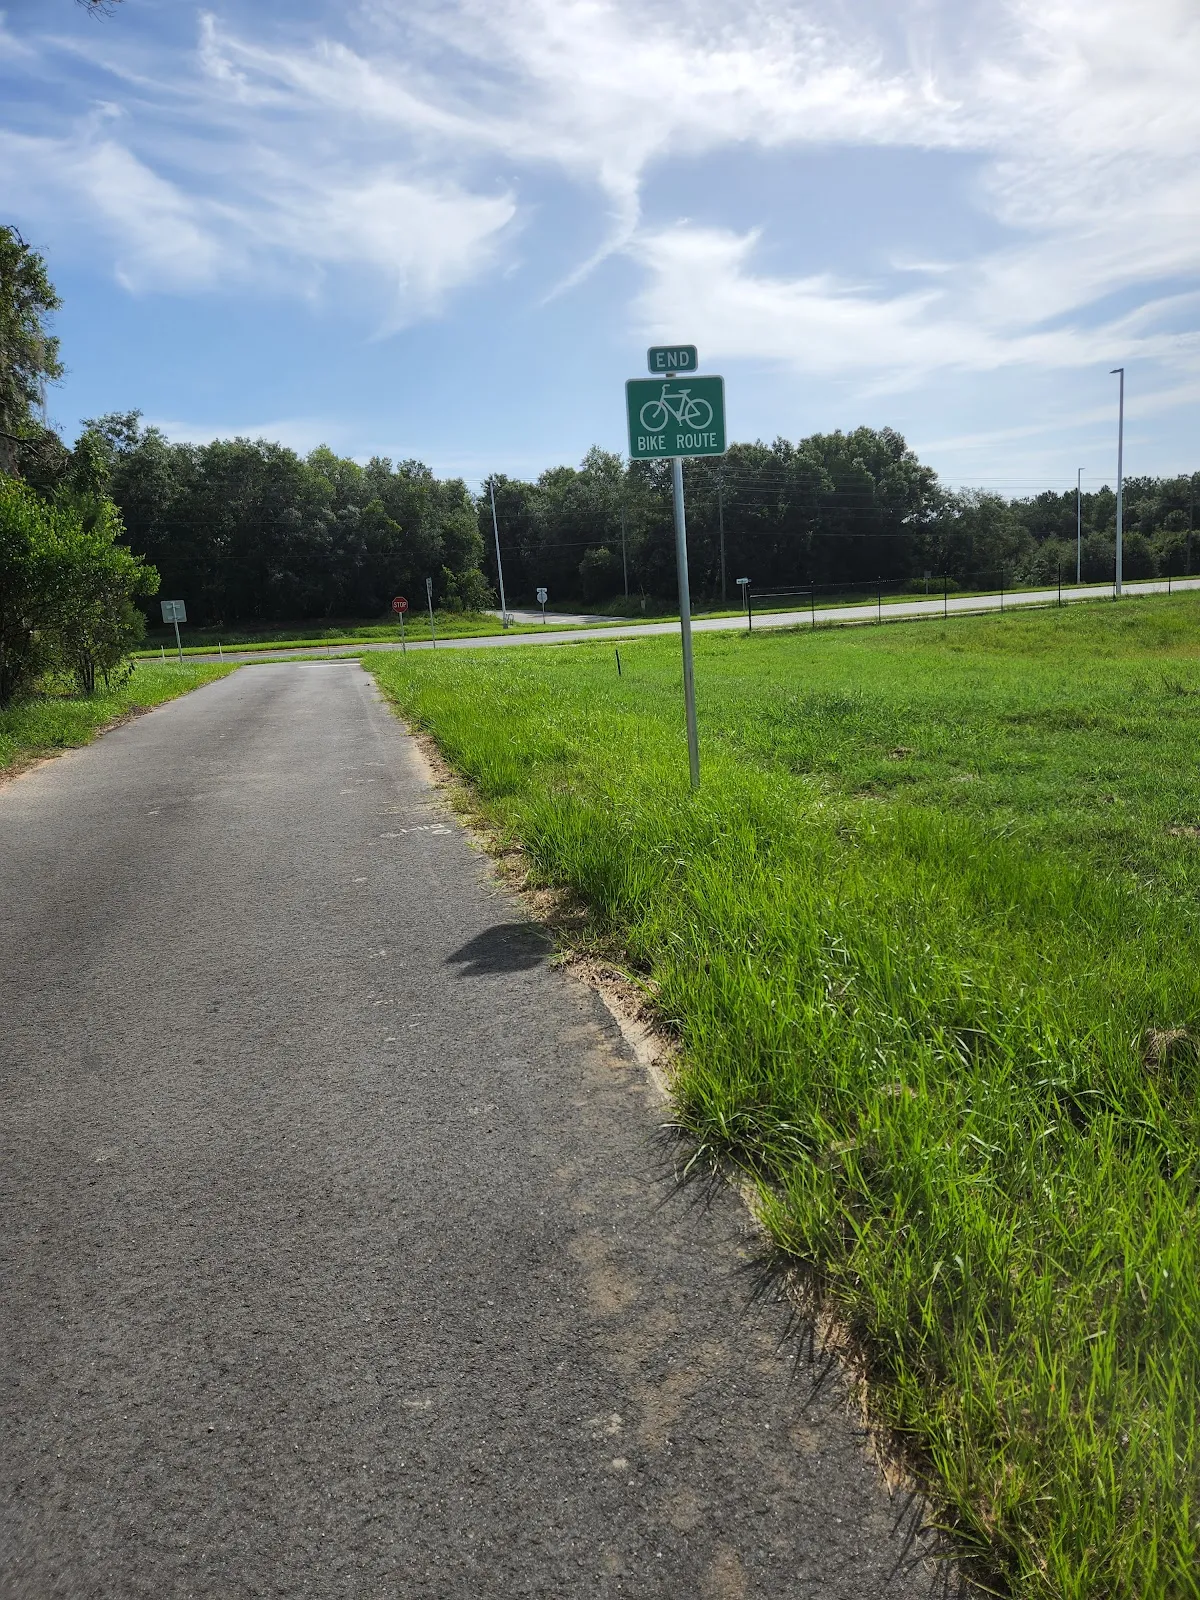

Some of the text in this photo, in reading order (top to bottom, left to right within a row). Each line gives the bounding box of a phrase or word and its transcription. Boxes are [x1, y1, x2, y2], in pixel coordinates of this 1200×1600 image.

[656, 351, 690, 368] END
[637, 432, 718, 451] BIKE ROUTE
